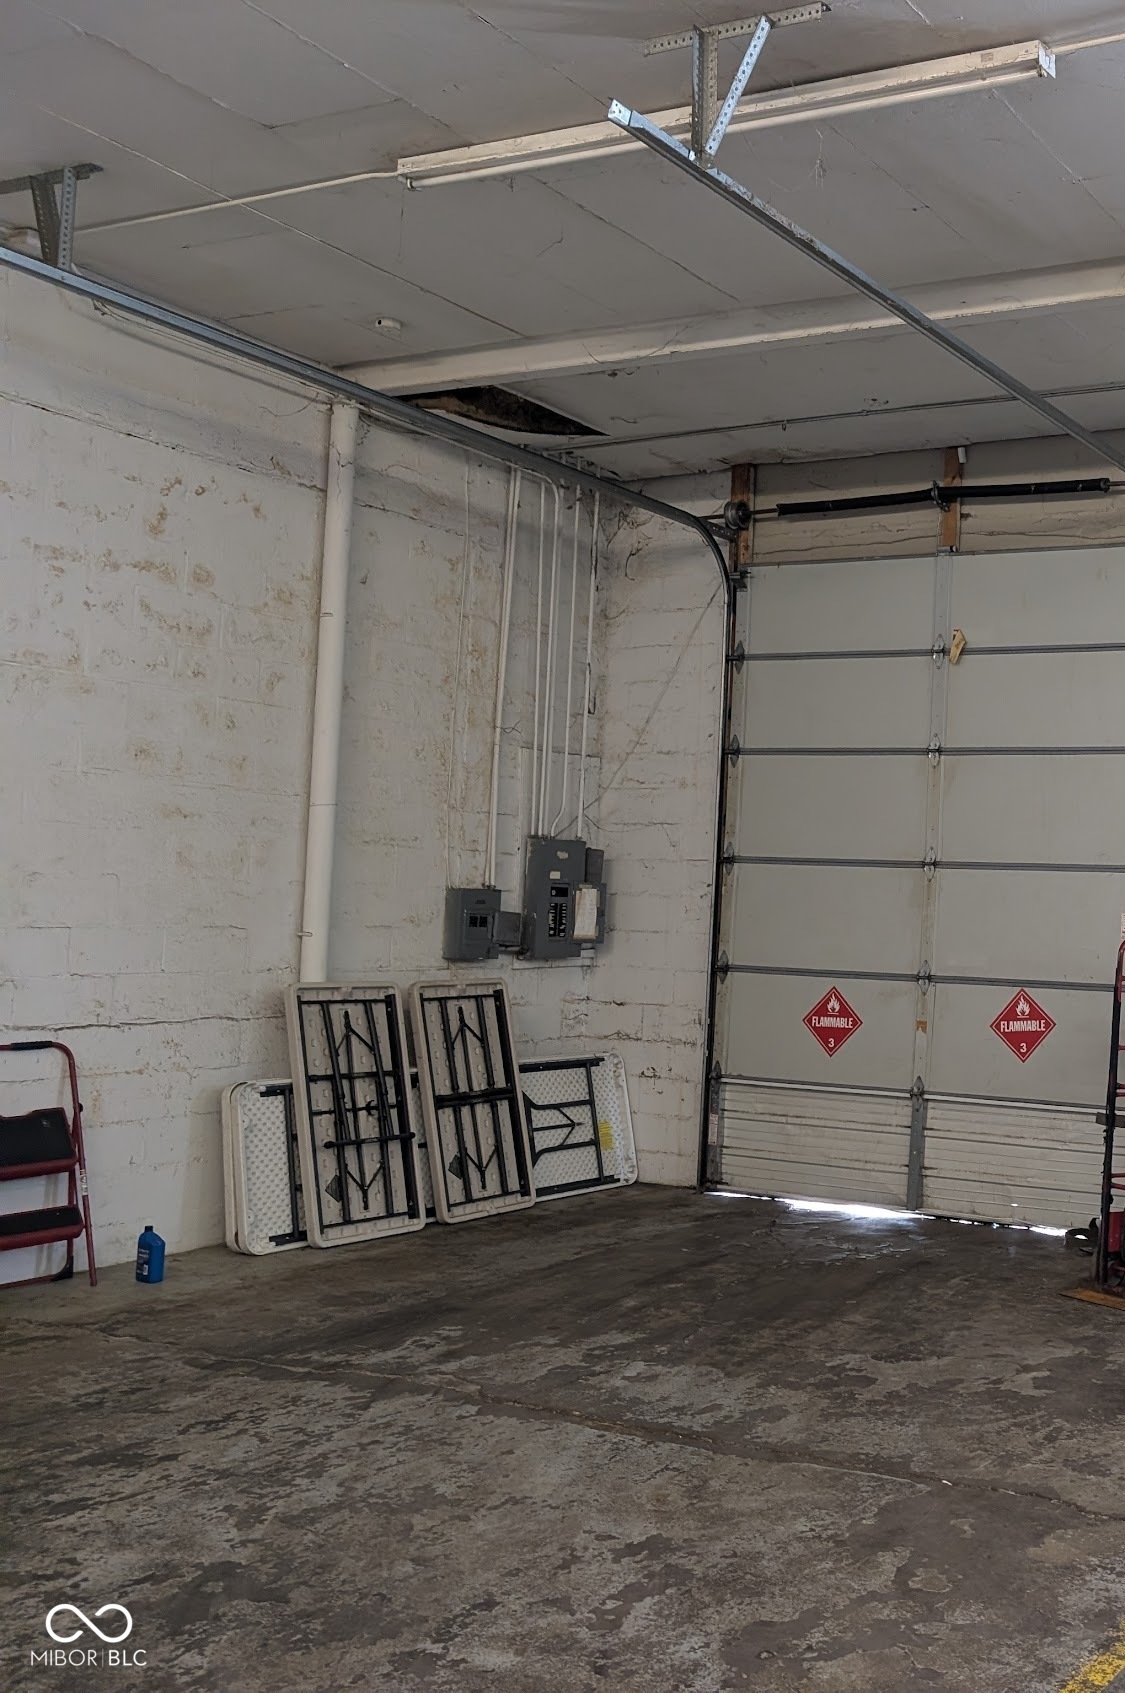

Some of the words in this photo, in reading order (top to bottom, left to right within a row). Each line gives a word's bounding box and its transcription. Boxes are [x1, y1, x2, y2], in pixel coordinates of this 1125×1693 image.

[811, 1015, 854, 1029] FLAMMABLE
[1000, 1019, 1046, 1033] FLAMMABLE
[828, 1037, 835, 1048] 3
[1019, 1042, 1027, 1053] 3
